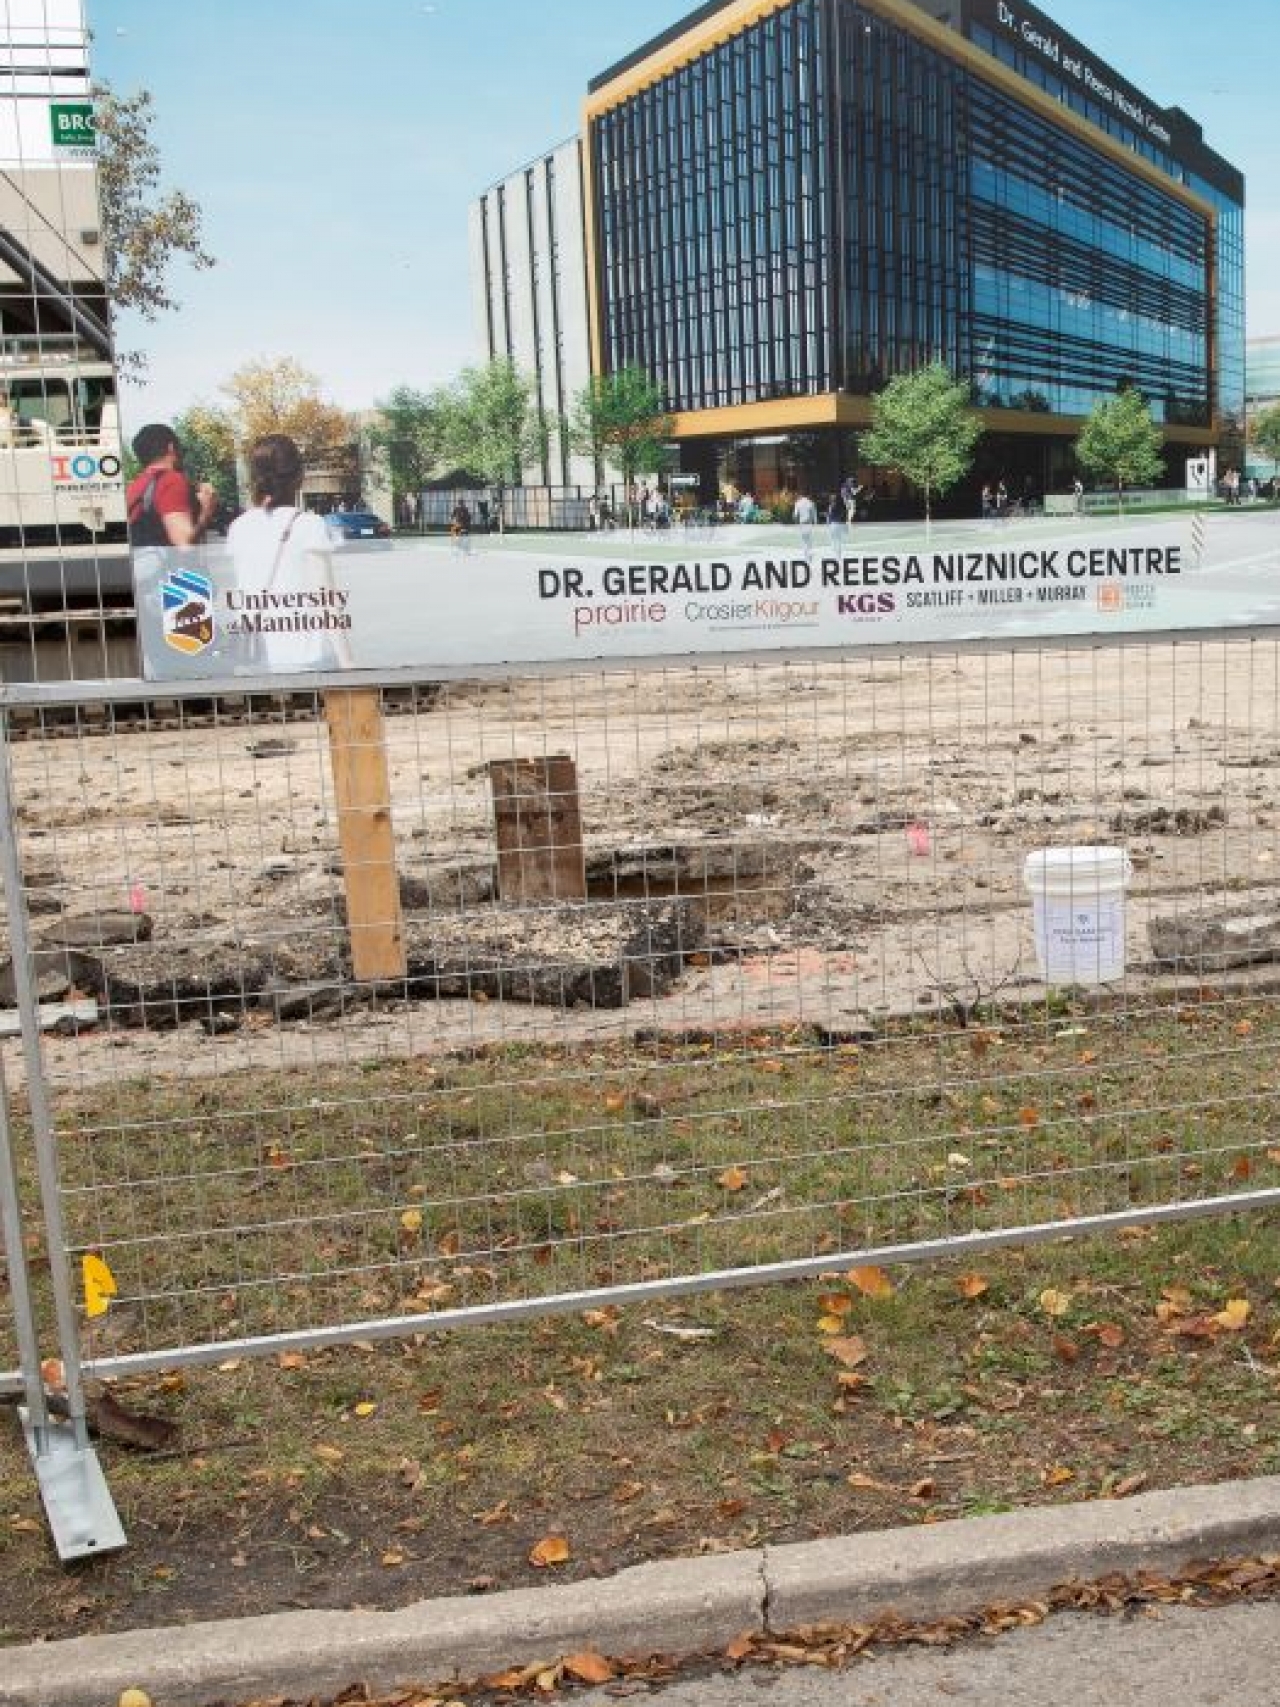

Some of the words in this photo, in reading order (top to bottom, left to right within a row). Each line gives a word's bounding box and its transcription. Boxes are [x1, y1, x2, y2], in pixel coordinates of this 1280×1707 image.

[538, 568, 594, 599] DR.
[602, 562, 732, 596] GERALD
[741, 560, 811, 591] AND
[821, 555, 924, 587] REESA
[933, 550, 1059, 583] NIZNICK
[1067, 546, 1181, 578] CENTRE
[226, 587, 349, 611] University
[837, 591, 896, 614] KGS
[906, 589, 964, 608] SCATLIFF
[978, 586, 1022, 606] MILLER
[1036, 584, 1087, 603] MURRAY
[241, 610, 352, 633] Manitoba
[574, 597, 667, 637] prairie
